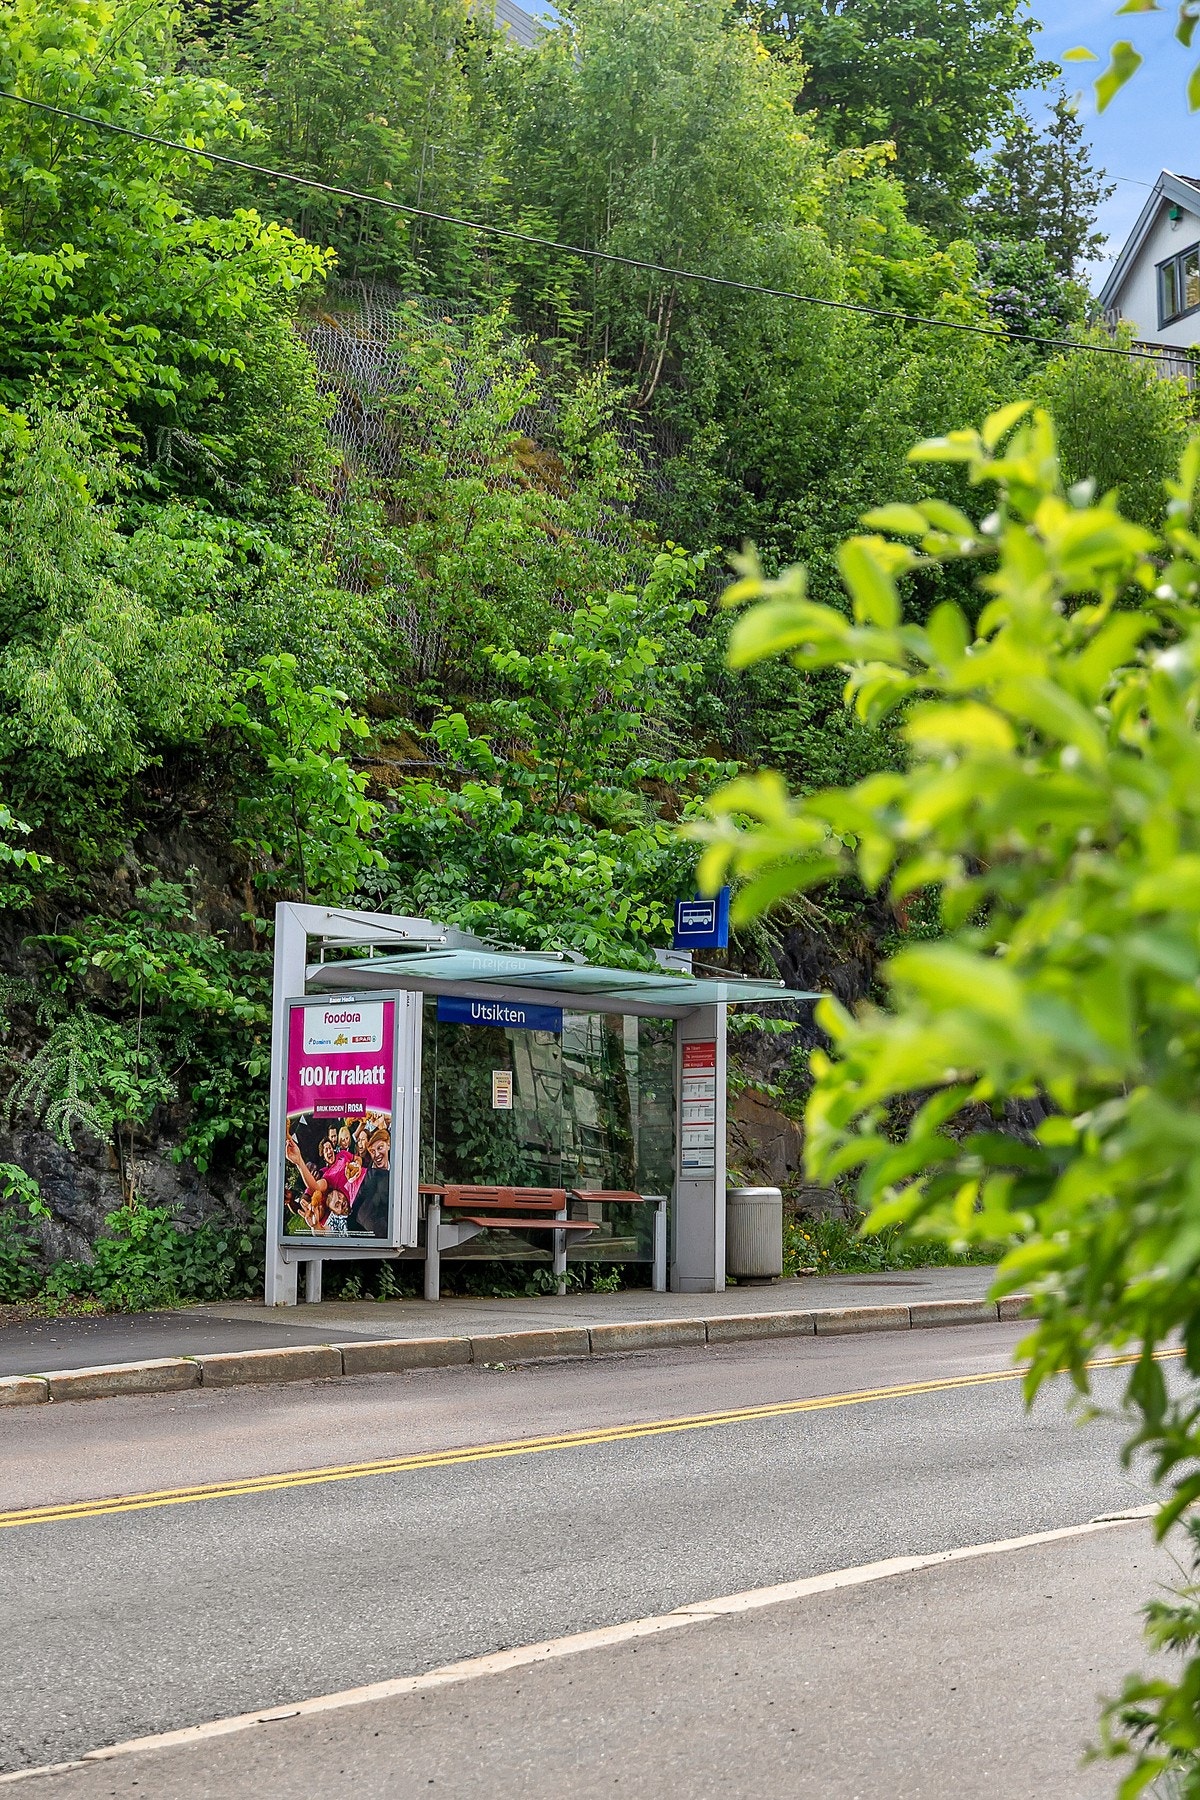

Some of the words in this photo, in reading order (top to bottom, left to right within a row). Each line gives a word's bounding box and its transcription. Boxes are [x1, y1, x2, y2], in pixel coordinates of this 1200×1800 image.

[324, 1011, 361, 1024] foodora
[471, 1002, 525, 1023] Utsikten
[299, 1066, 323, 1086] 100
[324, 1066, 340, 1085] kr
[340, 1065, 386, 1085] rabatt
[347, 1103, 364, 1112] ROSA
